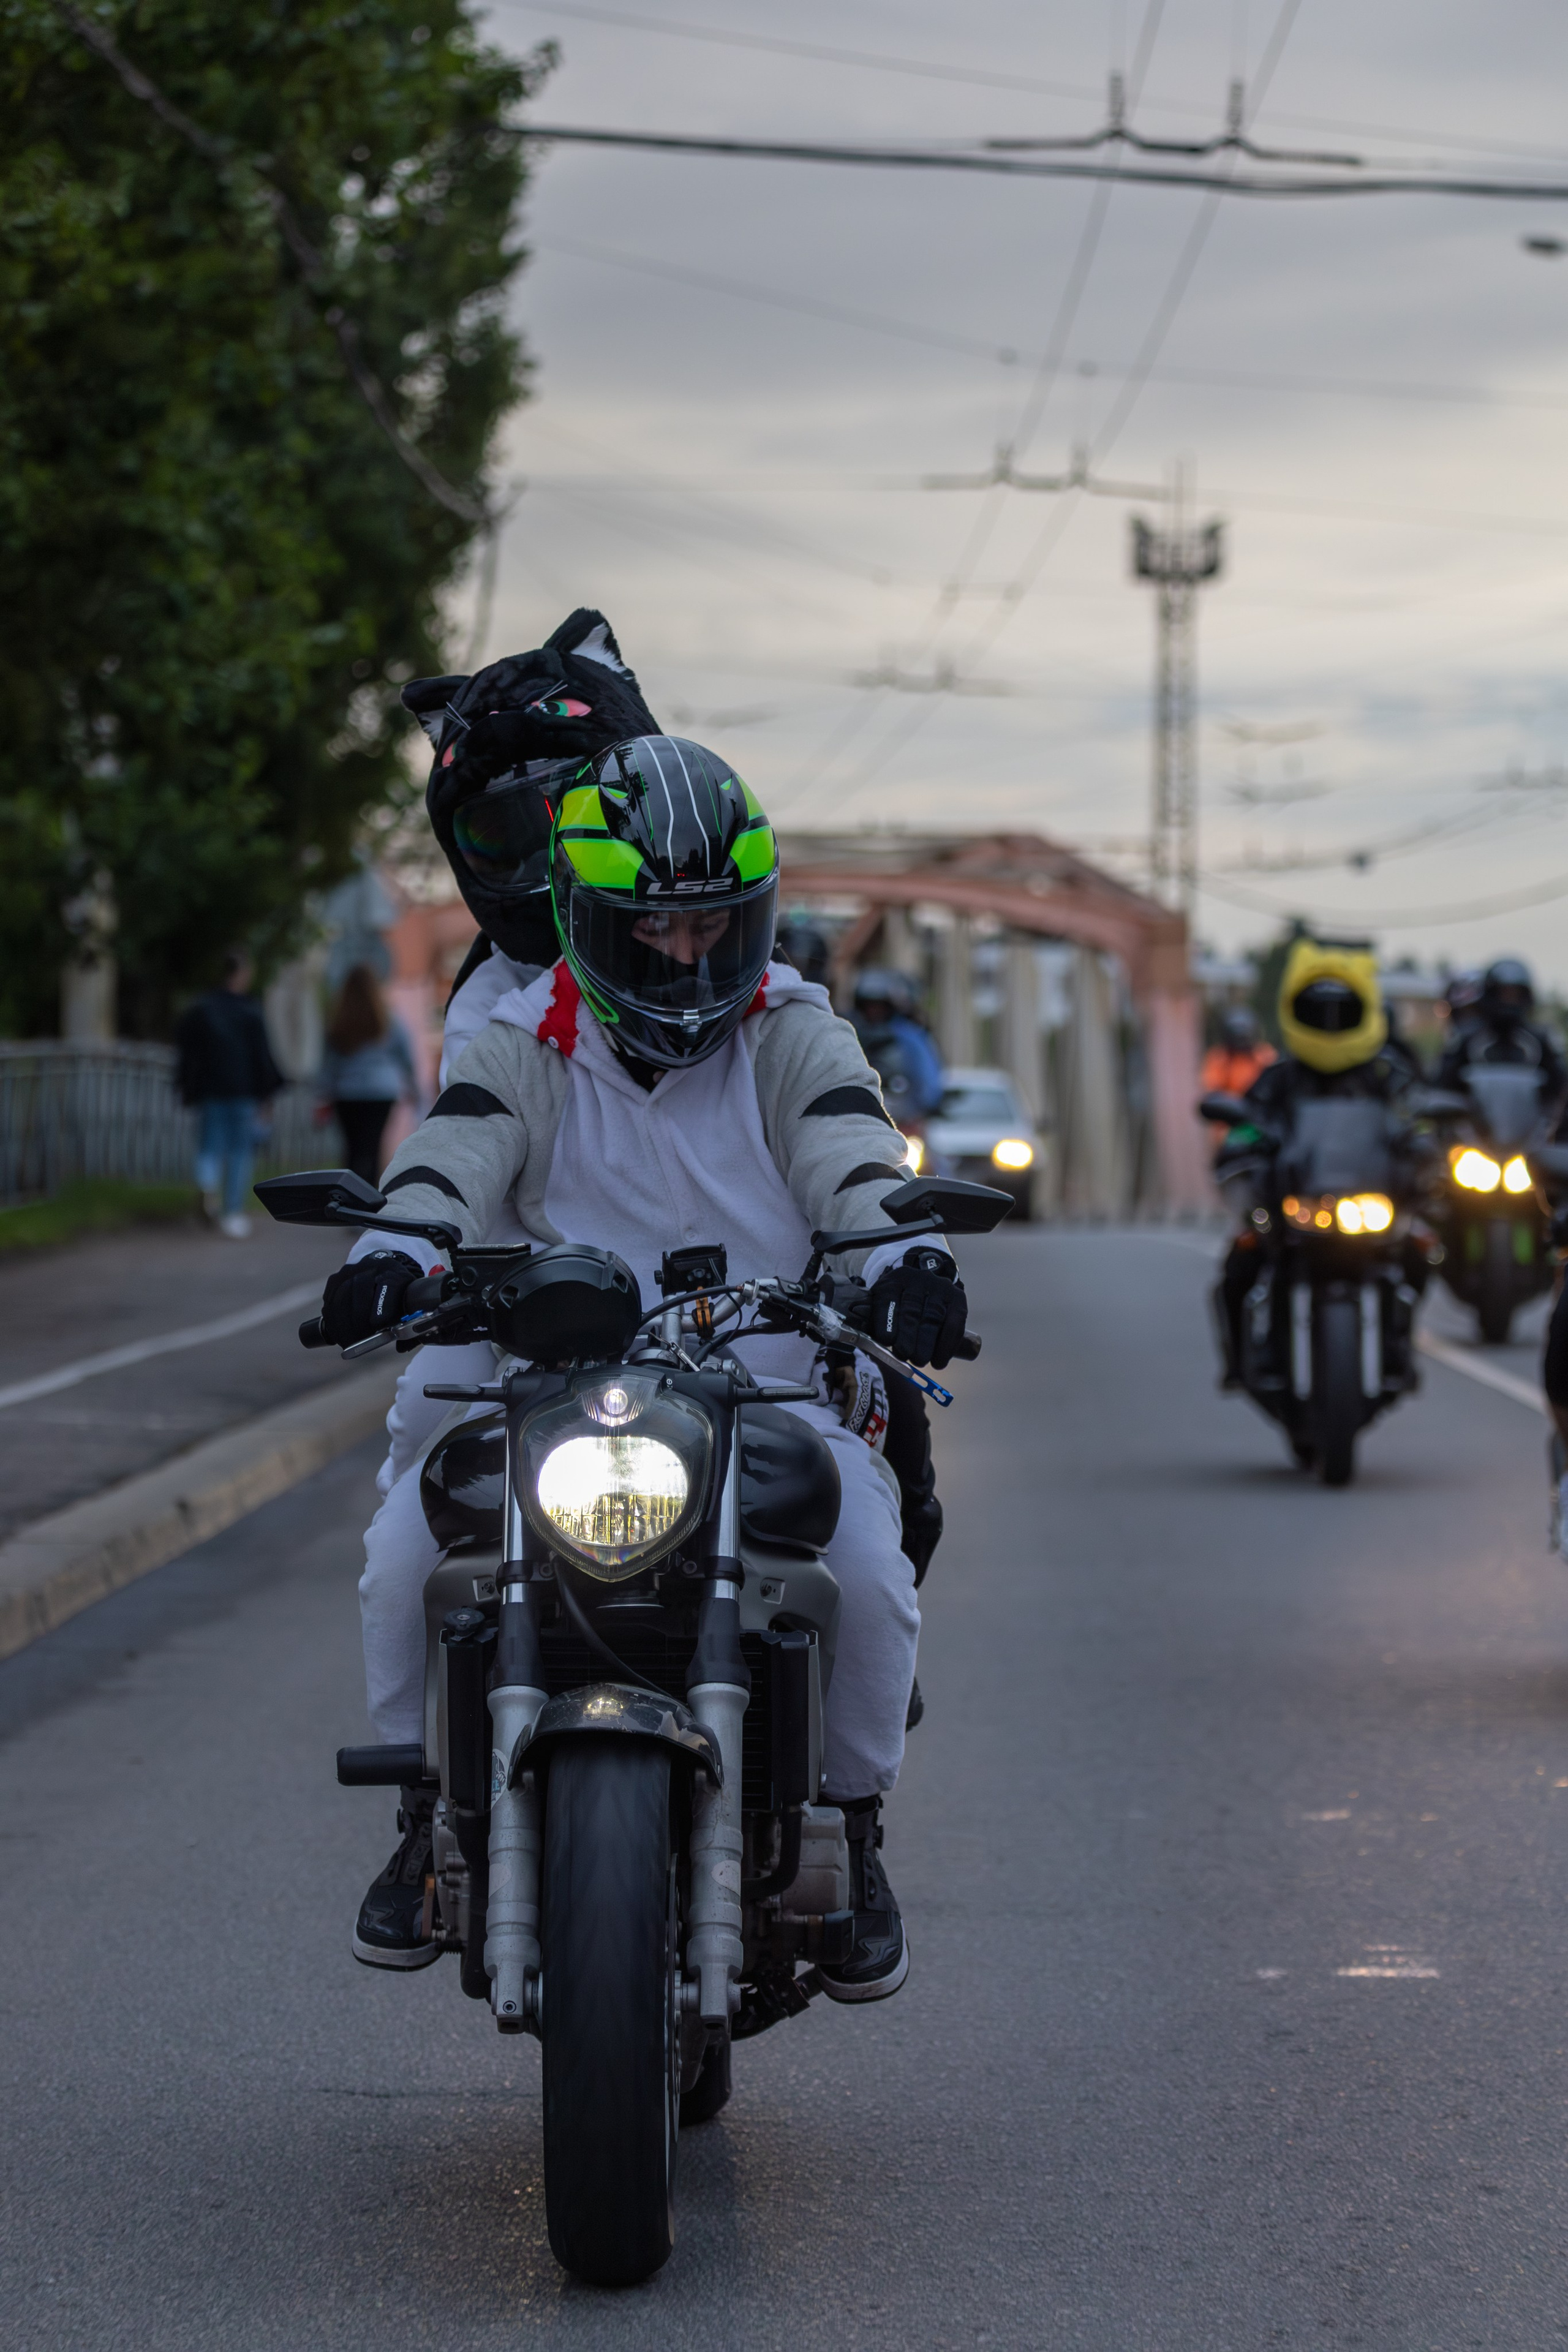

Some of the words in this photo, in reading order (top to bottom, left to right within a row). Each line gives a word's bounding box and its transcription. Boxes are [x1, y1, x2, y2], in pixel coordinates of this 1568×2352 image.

[646, 878, 734, 895] LS2
[377, 1285, 388, 1316] ROCKBROS
[886, 1301, 896, 1333] ROCKBROS
